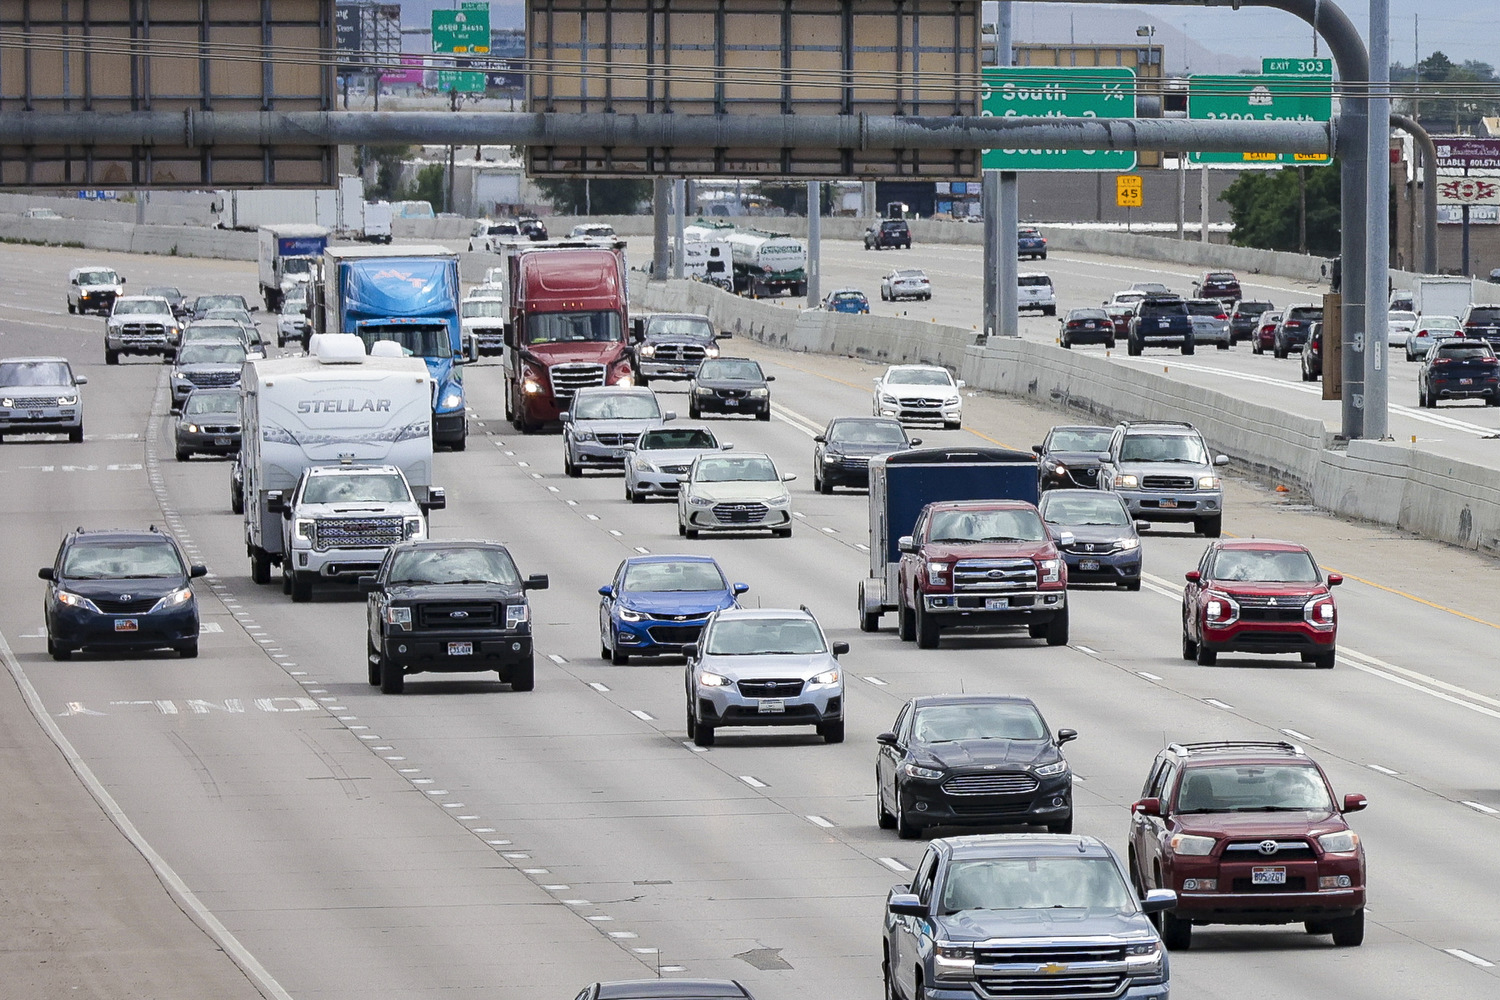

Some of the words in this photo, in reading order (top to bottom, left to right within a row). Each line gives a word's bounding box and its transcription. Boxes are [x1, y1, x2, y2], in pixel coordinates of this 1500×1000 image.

[1270, 62, 1290, 70] EXIT
[1297, 61, 1324, 72] 303
[1002, 82, 1067, 101] South
[1121, 189, 1138, 198] 45
[297, 399, 391, 413] STELLAR
